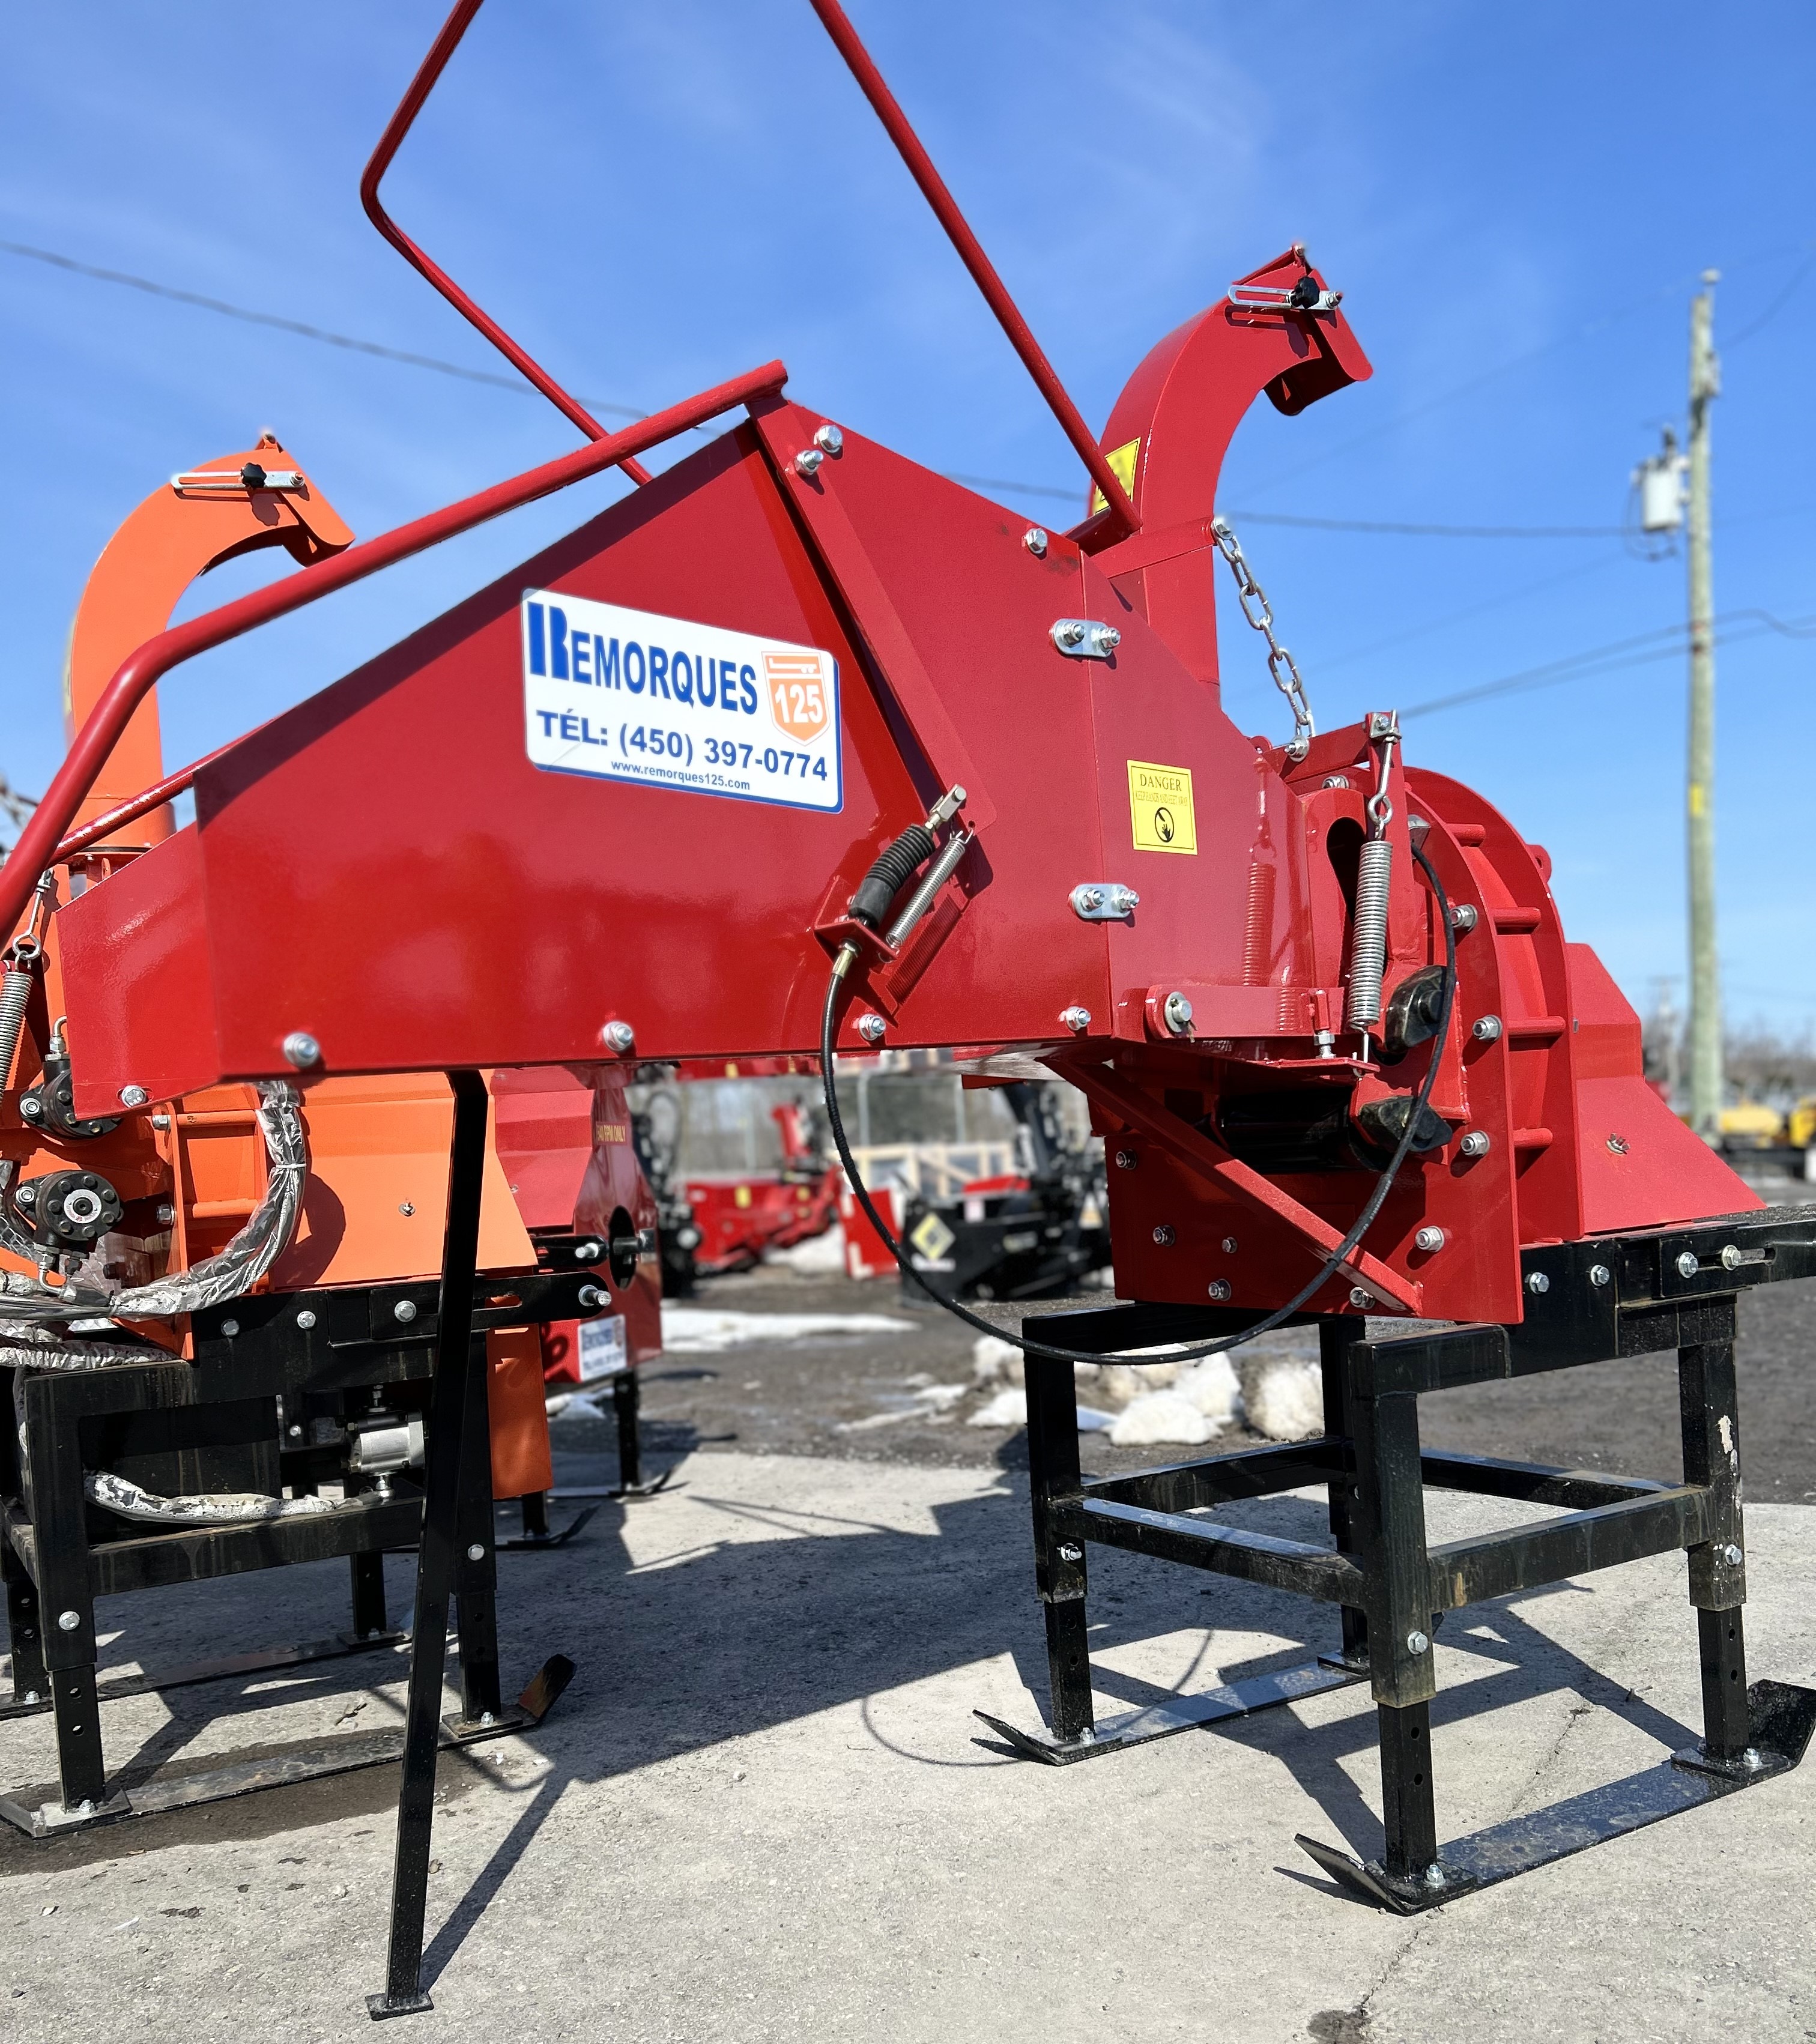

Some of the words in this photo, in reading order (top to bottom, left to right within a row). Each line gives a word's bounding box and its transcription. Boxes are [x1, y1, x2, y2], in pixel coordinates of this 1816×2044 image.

[527, 600, 758, 715] REMORQUES
[775, 684, 823, 724] 125
[536, 709, 608, 746] TÉL:
[620, 723, 693, 767] (450)
[704, 739, 828, 781] 397-0774
[611, 761, 750, 790] www.remorques125.com
[1140, 773, 1182, 791] DANGER
